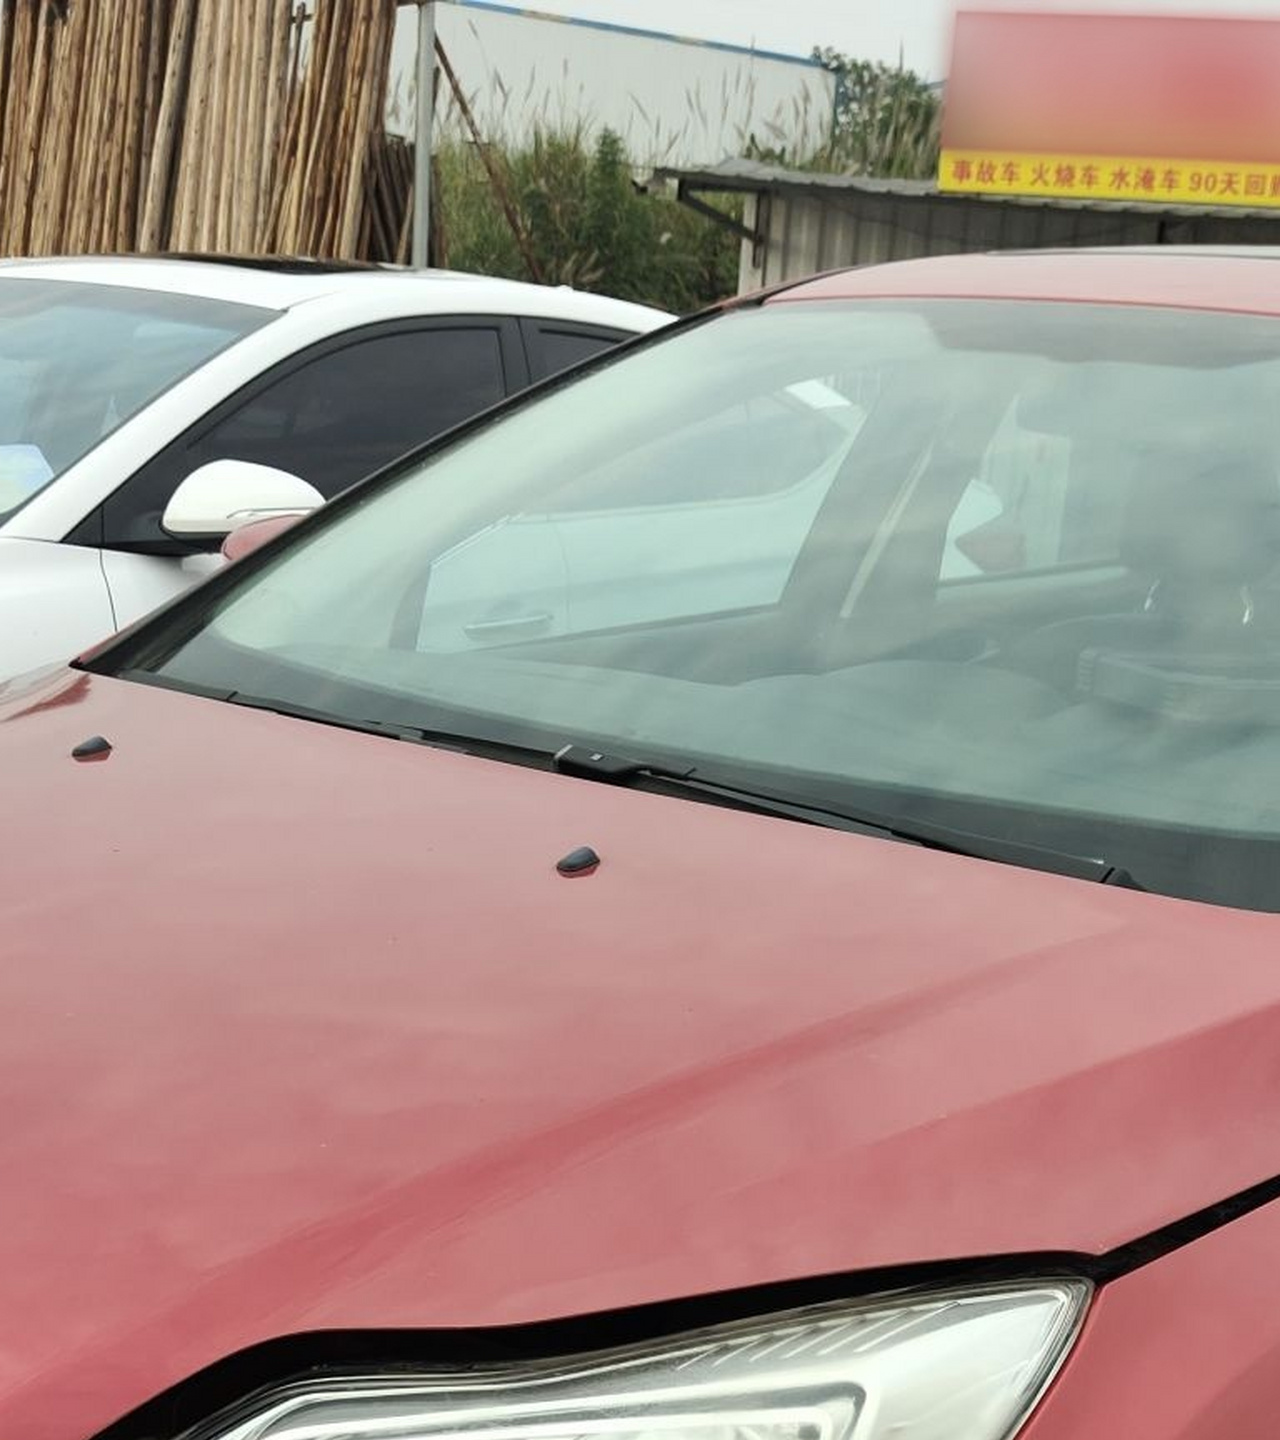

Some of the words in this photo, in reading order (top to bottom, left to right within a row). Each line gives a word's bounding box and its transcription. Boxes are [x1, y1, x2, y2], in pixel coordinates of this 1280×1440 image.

[952, 159, 1020, 186] 事故车
[1030, 162, 1101, 189] 火烧车
